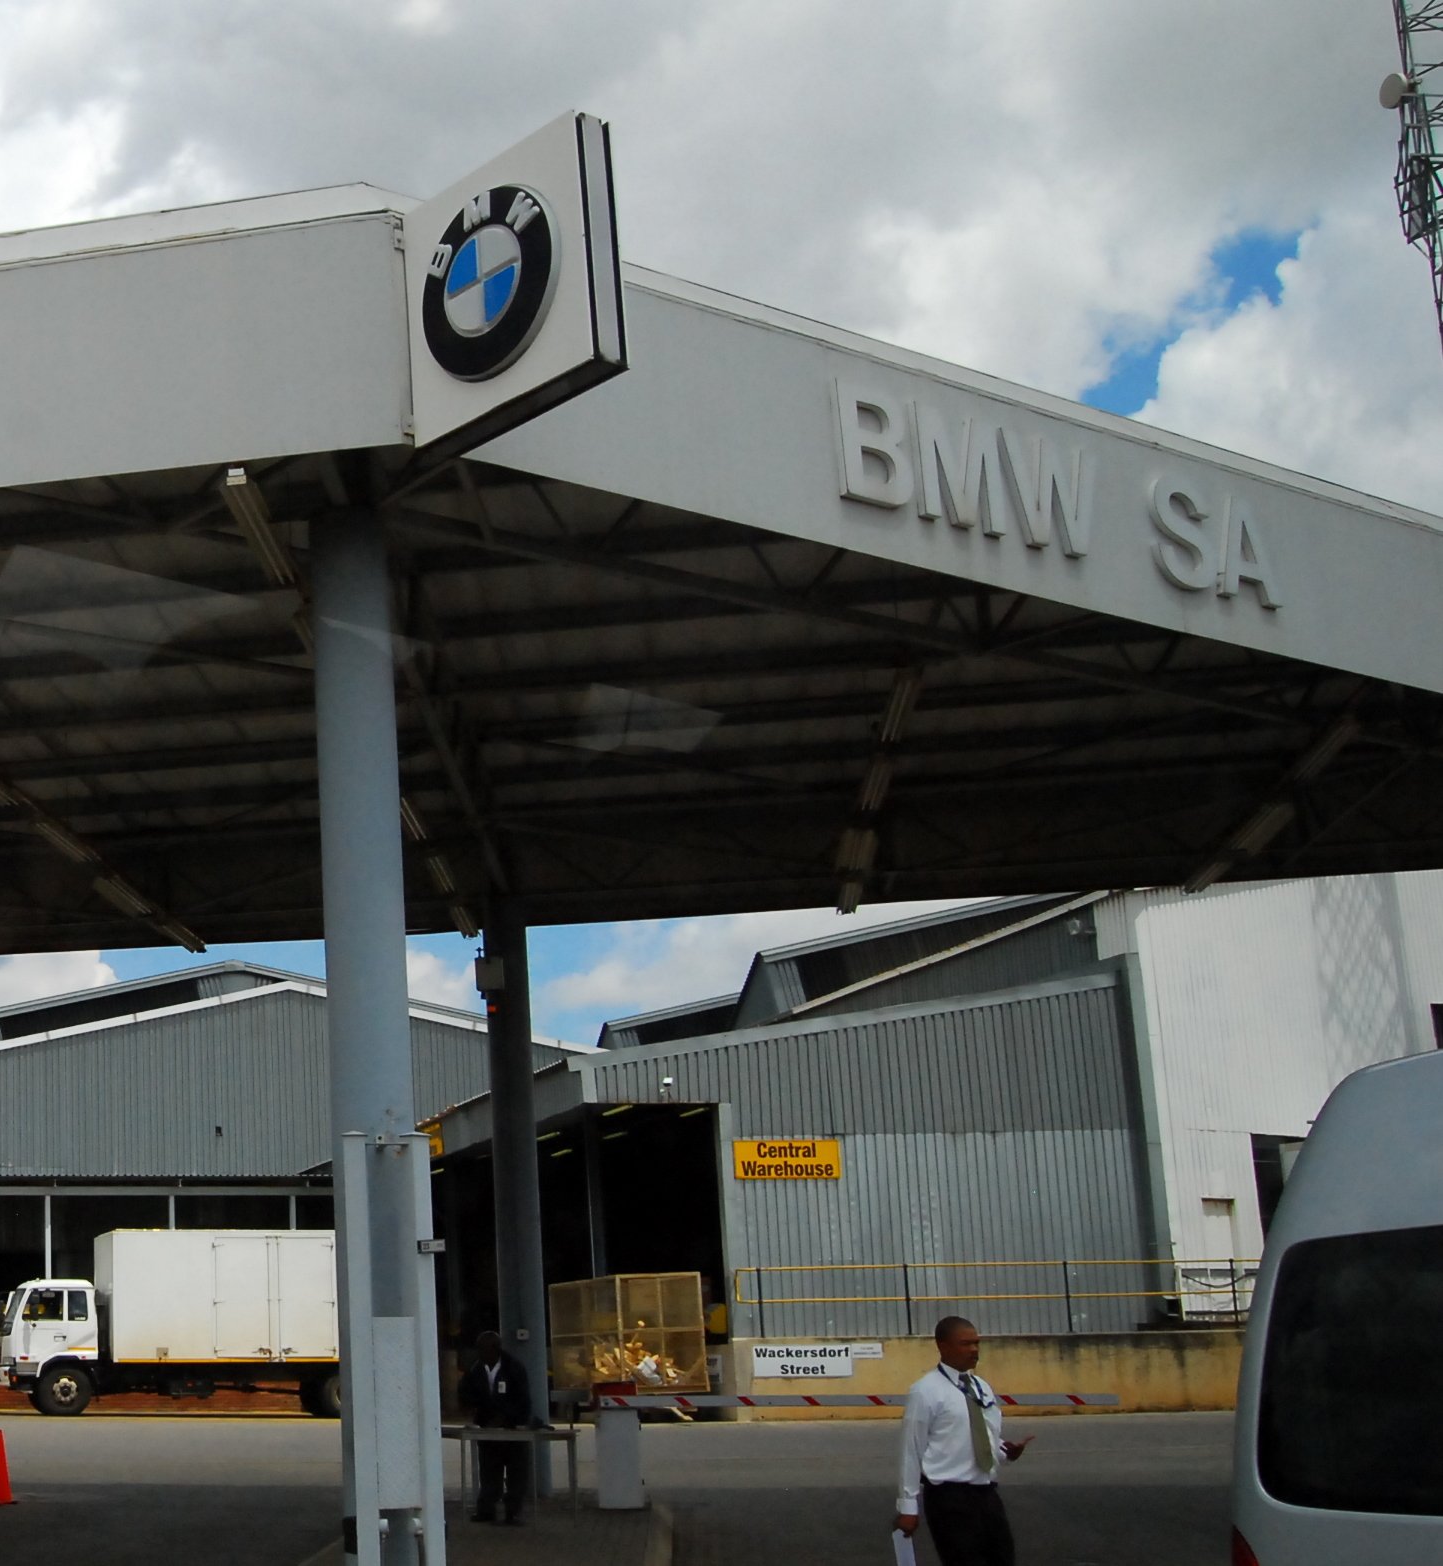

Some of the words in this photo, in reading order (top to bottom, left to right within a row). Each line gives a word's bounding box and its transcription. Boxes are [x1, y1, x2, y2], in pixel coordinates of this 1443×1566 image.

[428, 190, 541, 279] BMW
[829, 376, 1094, 561] BMW
[1149, 474, 1284, 612] SA
[757, 1142, 816, 1159] Central
[741, 1160, 834, 1177] Warehouse
[754, 1346, 850, 1359] Wackersdorf
[780, 1363, 826, 1376] Street
